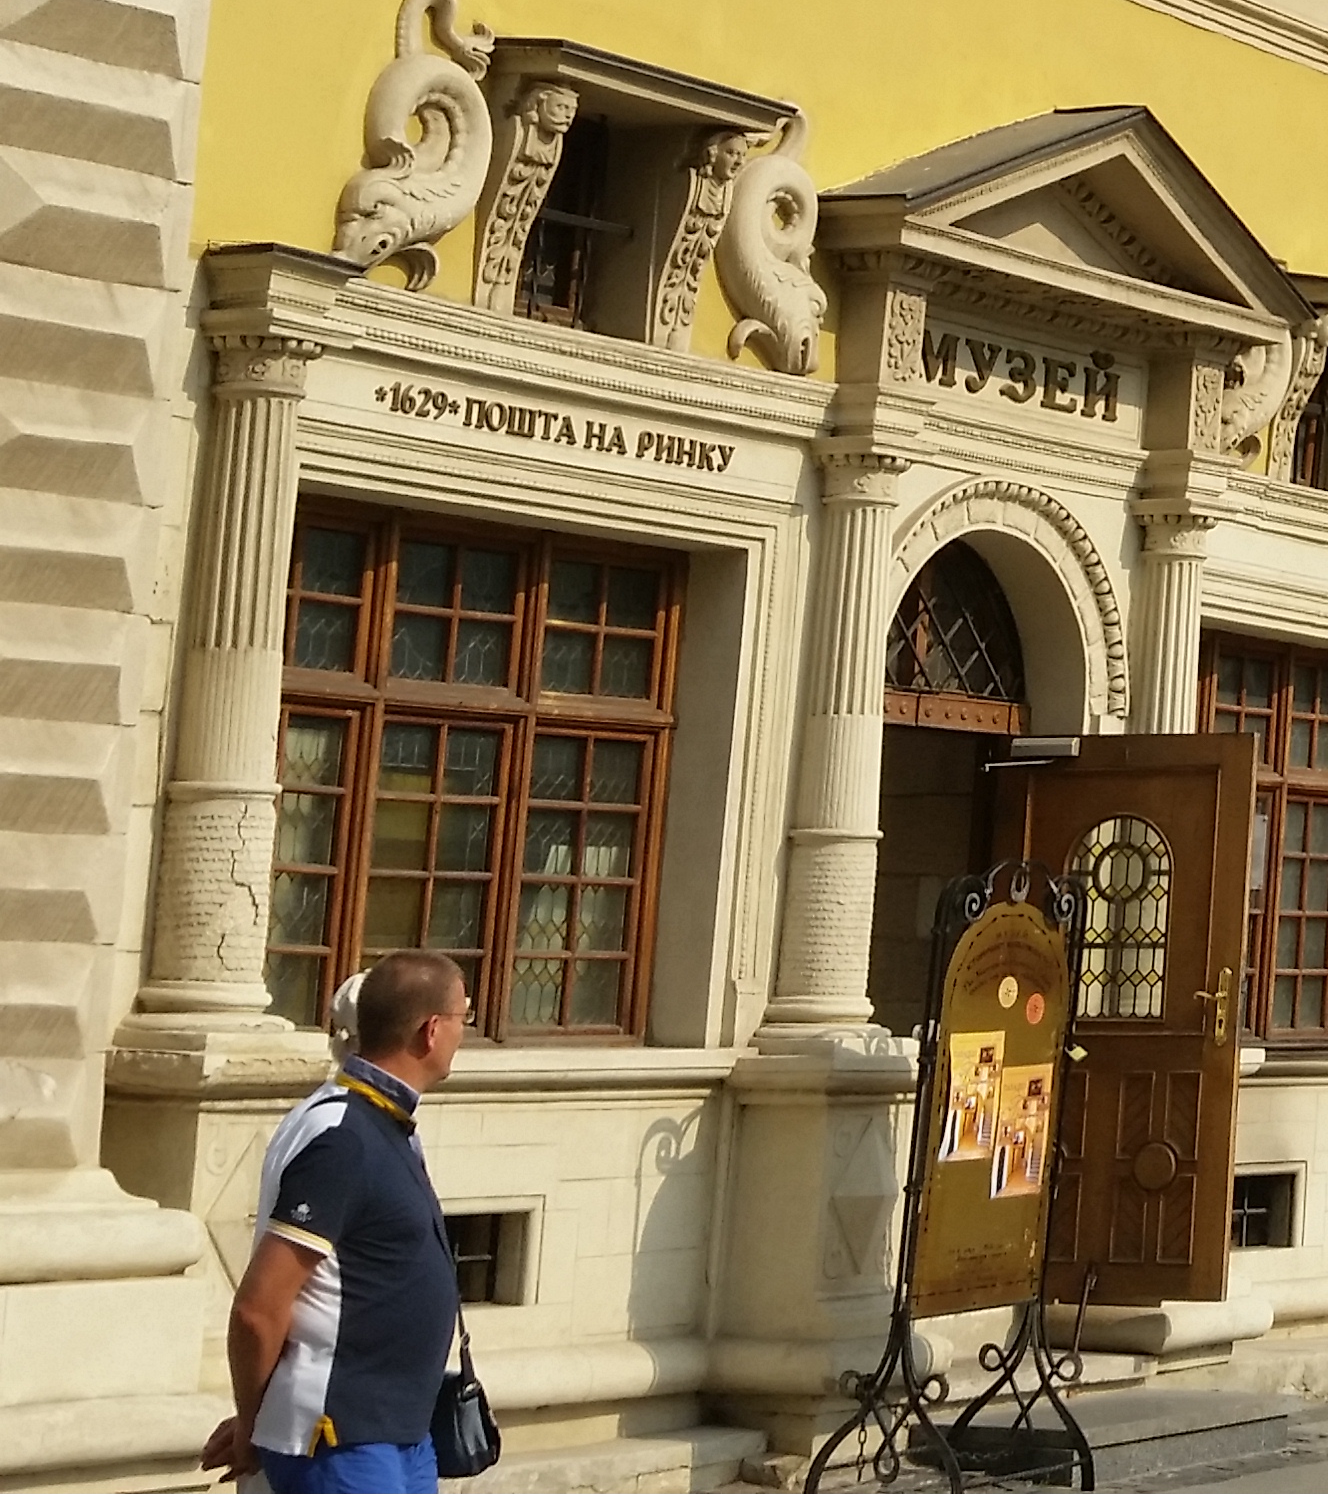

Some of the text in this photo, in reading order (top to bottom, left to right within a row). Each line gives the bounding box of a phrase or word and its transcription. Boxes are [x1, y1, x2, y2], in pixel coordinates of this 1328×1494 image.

[922, 329, 1120, 422] МУЗЕЙ
[461, 396, 577, 446] ПОШТА
[583, 419, 628, 455] НА
[635, 430, 737, 473] РИНКУ
